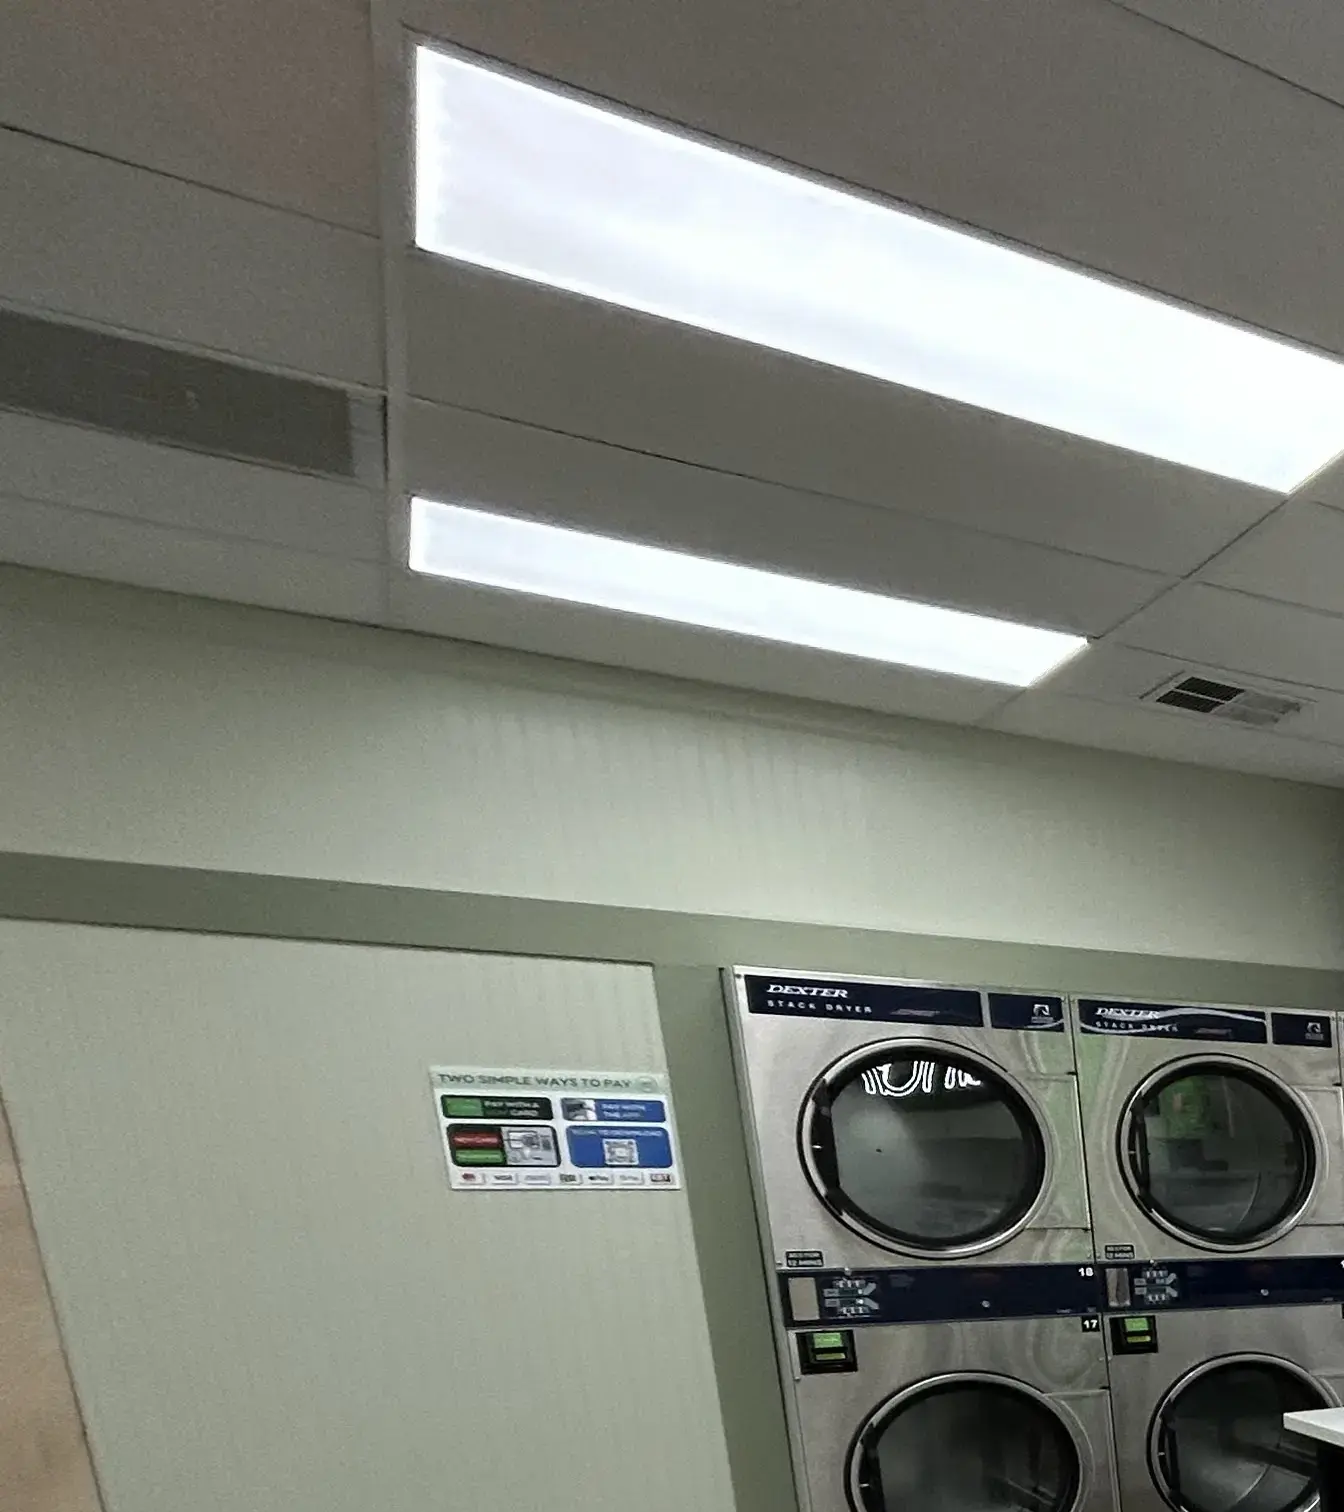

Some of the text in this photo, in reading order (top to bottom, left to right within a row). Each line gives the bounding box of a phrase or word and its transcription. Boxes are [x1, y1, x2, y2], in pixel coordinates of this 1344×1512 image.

[766, 984, 849, 999] DEXTER
[767, 1000, 873, 1014] STACK DRYER
[1095, 1007, 1161, 1020] DEXTER
[438, 1073, 632, 1088] TWO SIMPLE WAYS TO PAY
[1078, 1267, 1094, 1277] 18
[1083, 1319, 1098, 1330] 17
